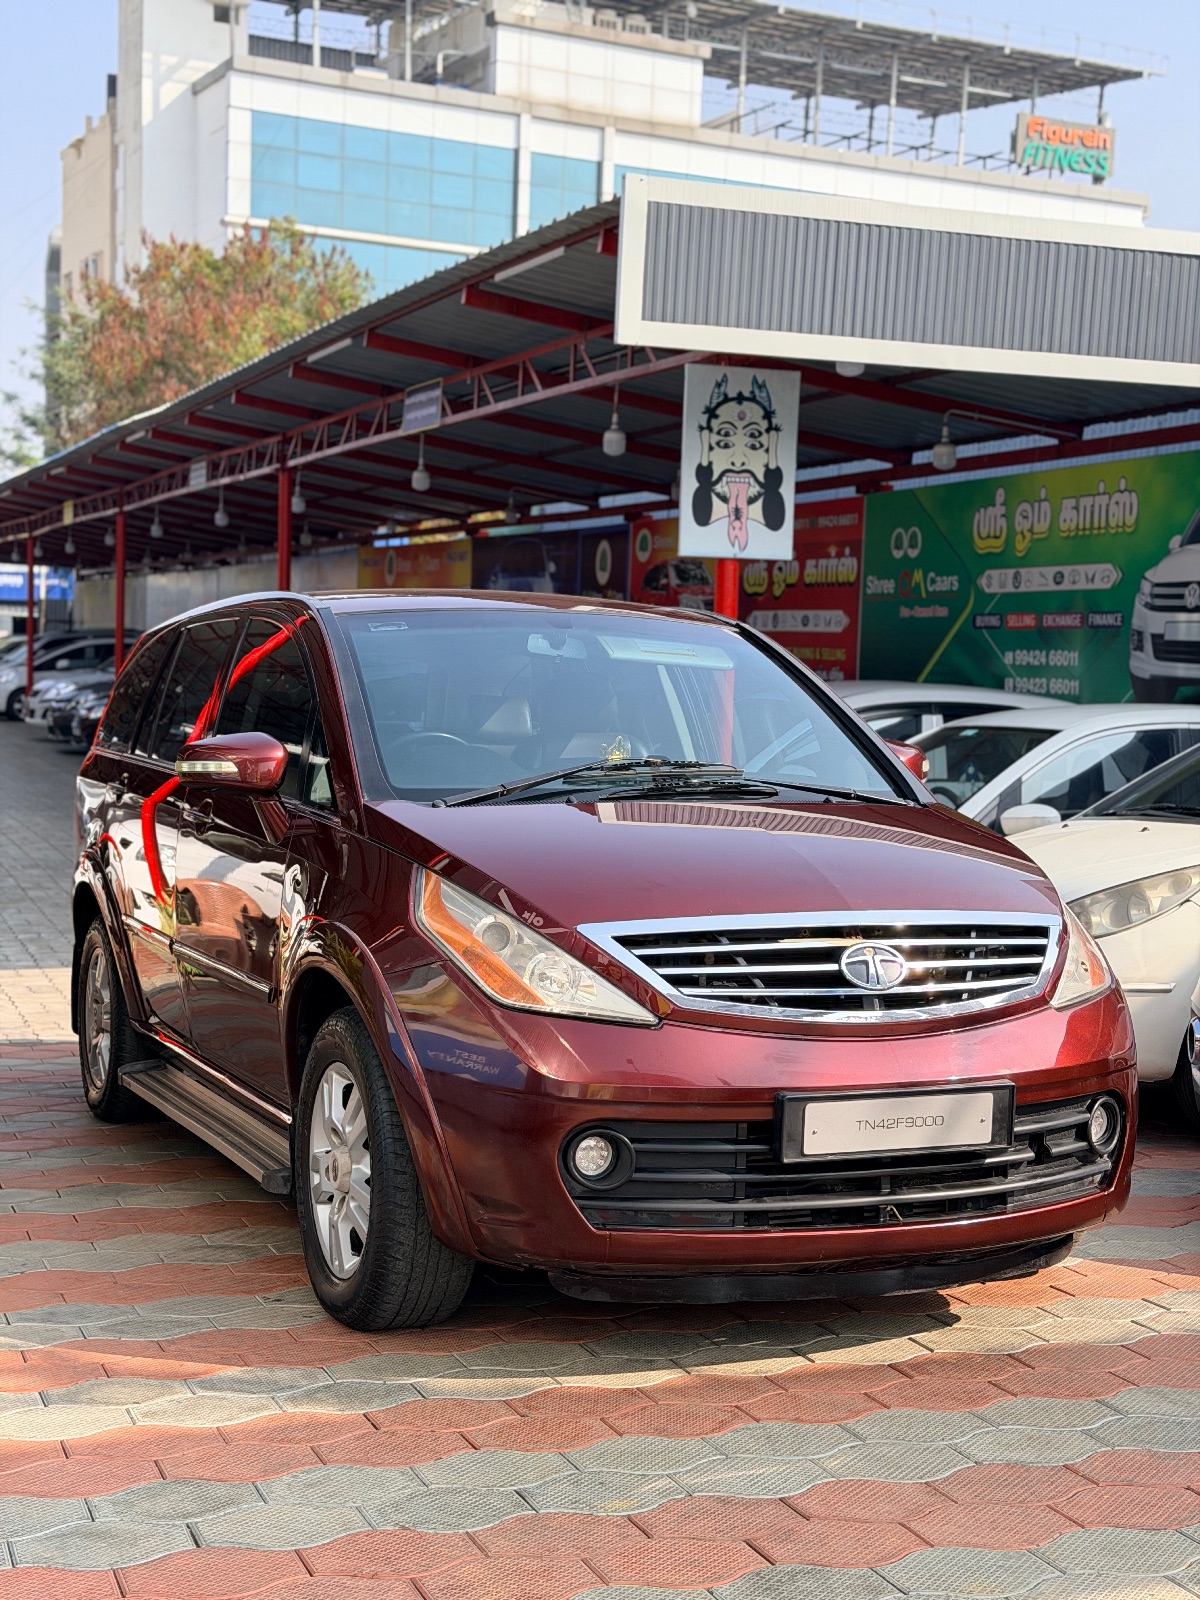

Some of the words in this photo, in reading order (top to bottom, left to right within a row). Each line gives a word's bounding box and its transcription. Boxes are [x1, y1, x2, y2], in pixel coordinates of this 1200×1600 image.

[1023, 142, 1110, 175] FITNESS
[866, 574, 895, 595] Shree
[926, 571, 959, 592] Caars
[975, 614, 1001, 627] BUYING
[1007, 613, 1036, 628] SELLING
[1042, 613, 1082, 627] EXCHANGE
[1088, 612, 1123, 626] FINANCE
[1014, 649, 1046, 665] 99424
[1048, 650, 1079, 667] 66011
[1014, 677, 1046, 694] 99423
[1049, 679, 1079, 695] 66011
[856, 1115, 944, 1131] TN42F9000
